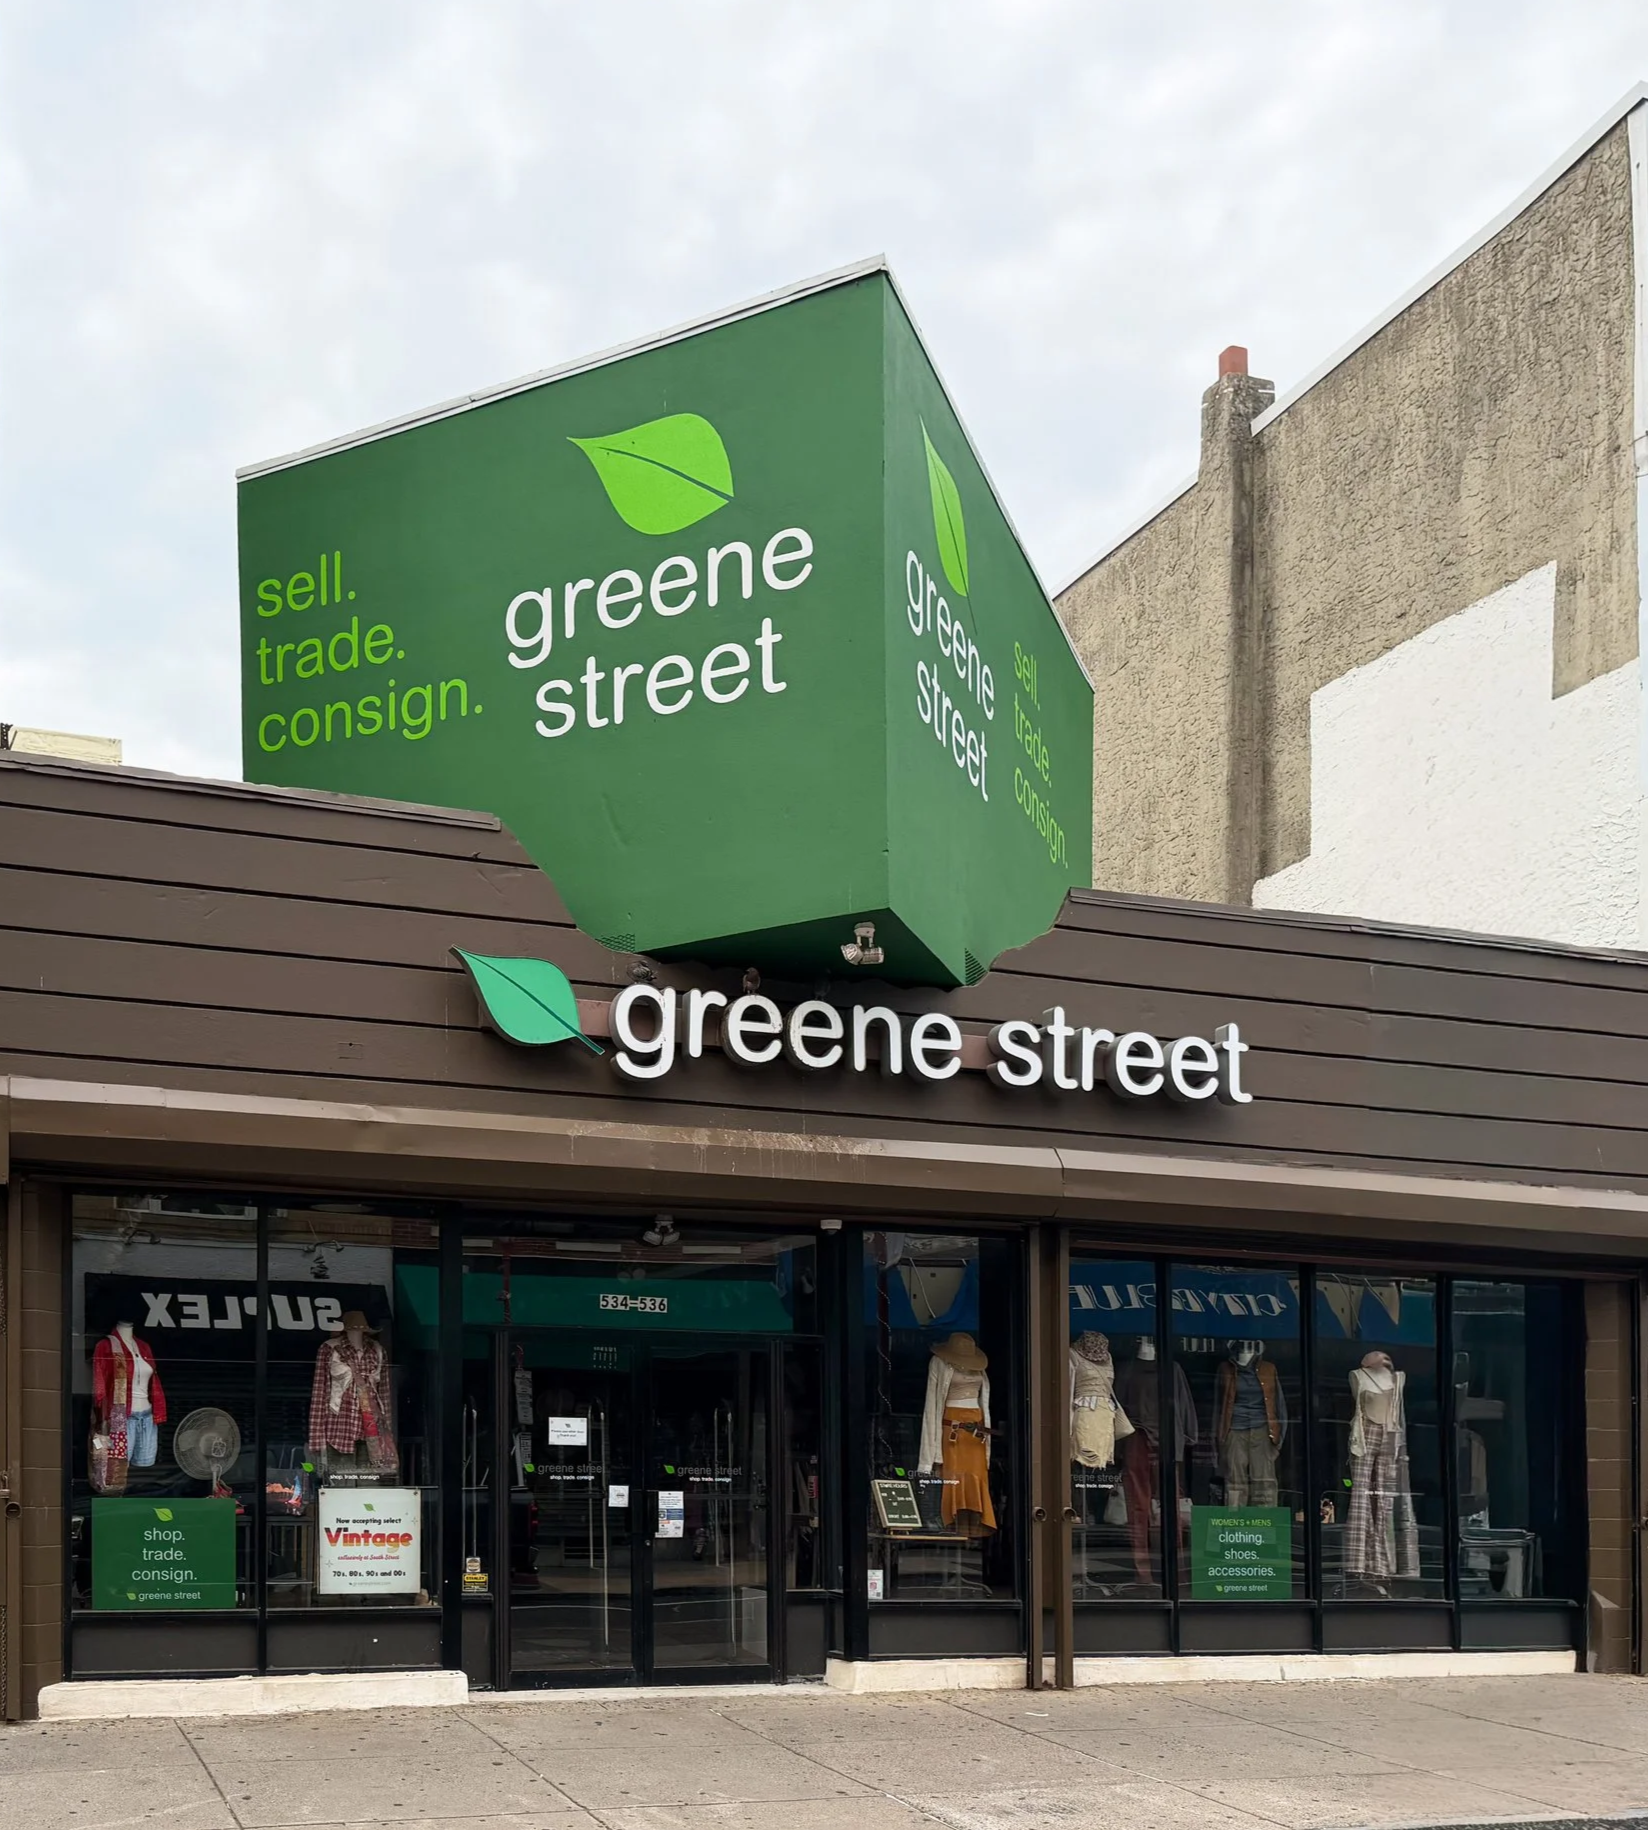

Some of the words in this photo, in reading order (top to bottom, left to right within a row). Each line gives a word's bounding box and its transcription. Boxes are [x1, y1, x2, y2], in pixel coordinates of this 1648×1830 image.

[256, 550, 357, 618] sell.
[505, 527, 814, 669] greene
[906, 550, 995, 720] greene
[256, 616, 406, 685] trade.
[535, 617, 787, 739] street
[1014, 641, 1041, 711] sell.
[258, 676, 484, 752] consign.
[917, 660, 989, 802] street
[1014, 693, 1052, 788] trade.
[1014, 767, 1068, 869] consign.
[609, 983, 963, 1081] greene
[993, 1005, 1254, 1105] street
[601, 1295, 666, 1311] 534-536
[538, 1464, 574, 1475] greene
[677, 1466, 712, 1476] greene
[714, 1466, 742, 1475] street
[1097, 1473, 1123, 1482] street
[352, 1517, 382, 1526] accepting
[1252, 1519, 1272, 1527] MENS
[143, 1527, 185, 1543] shop.
[324, 1527, 413, 1553] Vintage
[1218, 1531, 1265, 1546] clothing.
[142, 1547, 187, 1561] trade.
[1224, 1548, 1260, 1560] shoes.
[131, 1567, 197, 1584] consign.
[1208, 1565, 1277, 1577] accessories.
[138, 1592, 172, 1602] greene
[174, 1591, 201, 1600] street
[1223, 1585, 1247, 1593] greene
[1248, 1584, 1268, 1592] street
